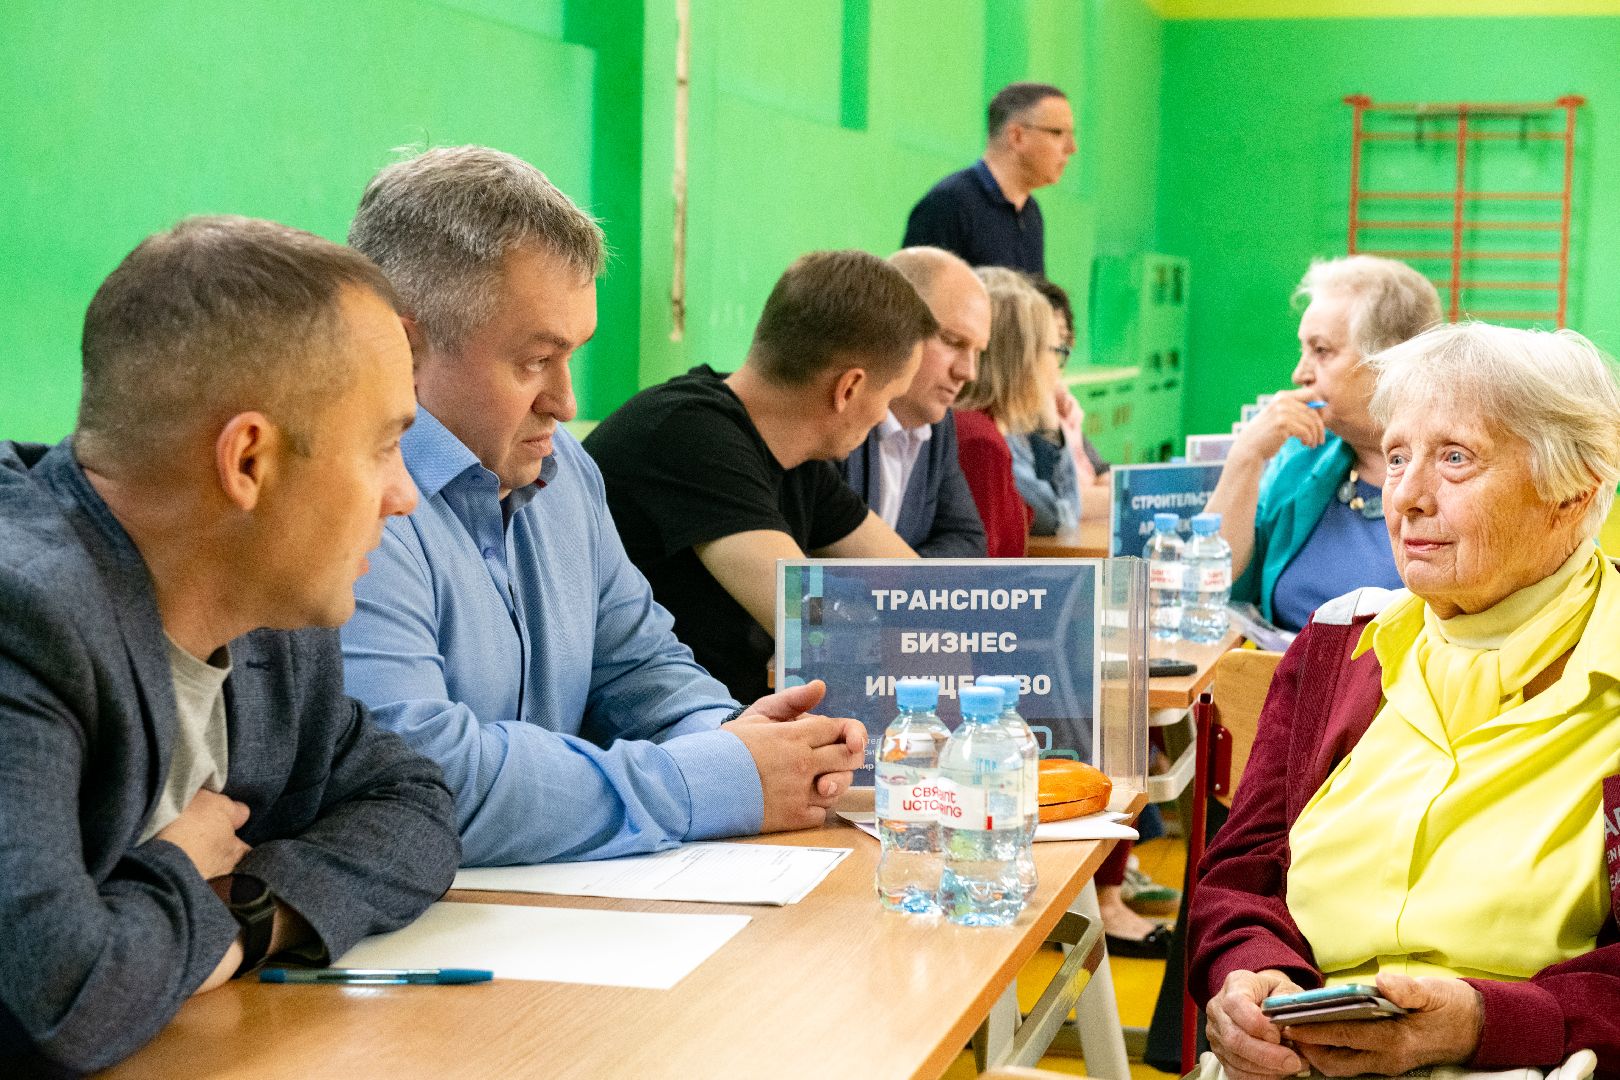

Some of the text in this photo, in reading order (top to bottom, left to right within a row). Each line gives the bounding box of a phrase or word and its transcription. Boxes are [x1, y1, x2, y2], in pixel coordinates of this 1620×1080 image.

[871, 589, 1047, 610] ТРАНСПОРТ
[901, 631, 1017, 653] БИЗНЕС
[865, 674, 1051, 699] ИЩЕВО
